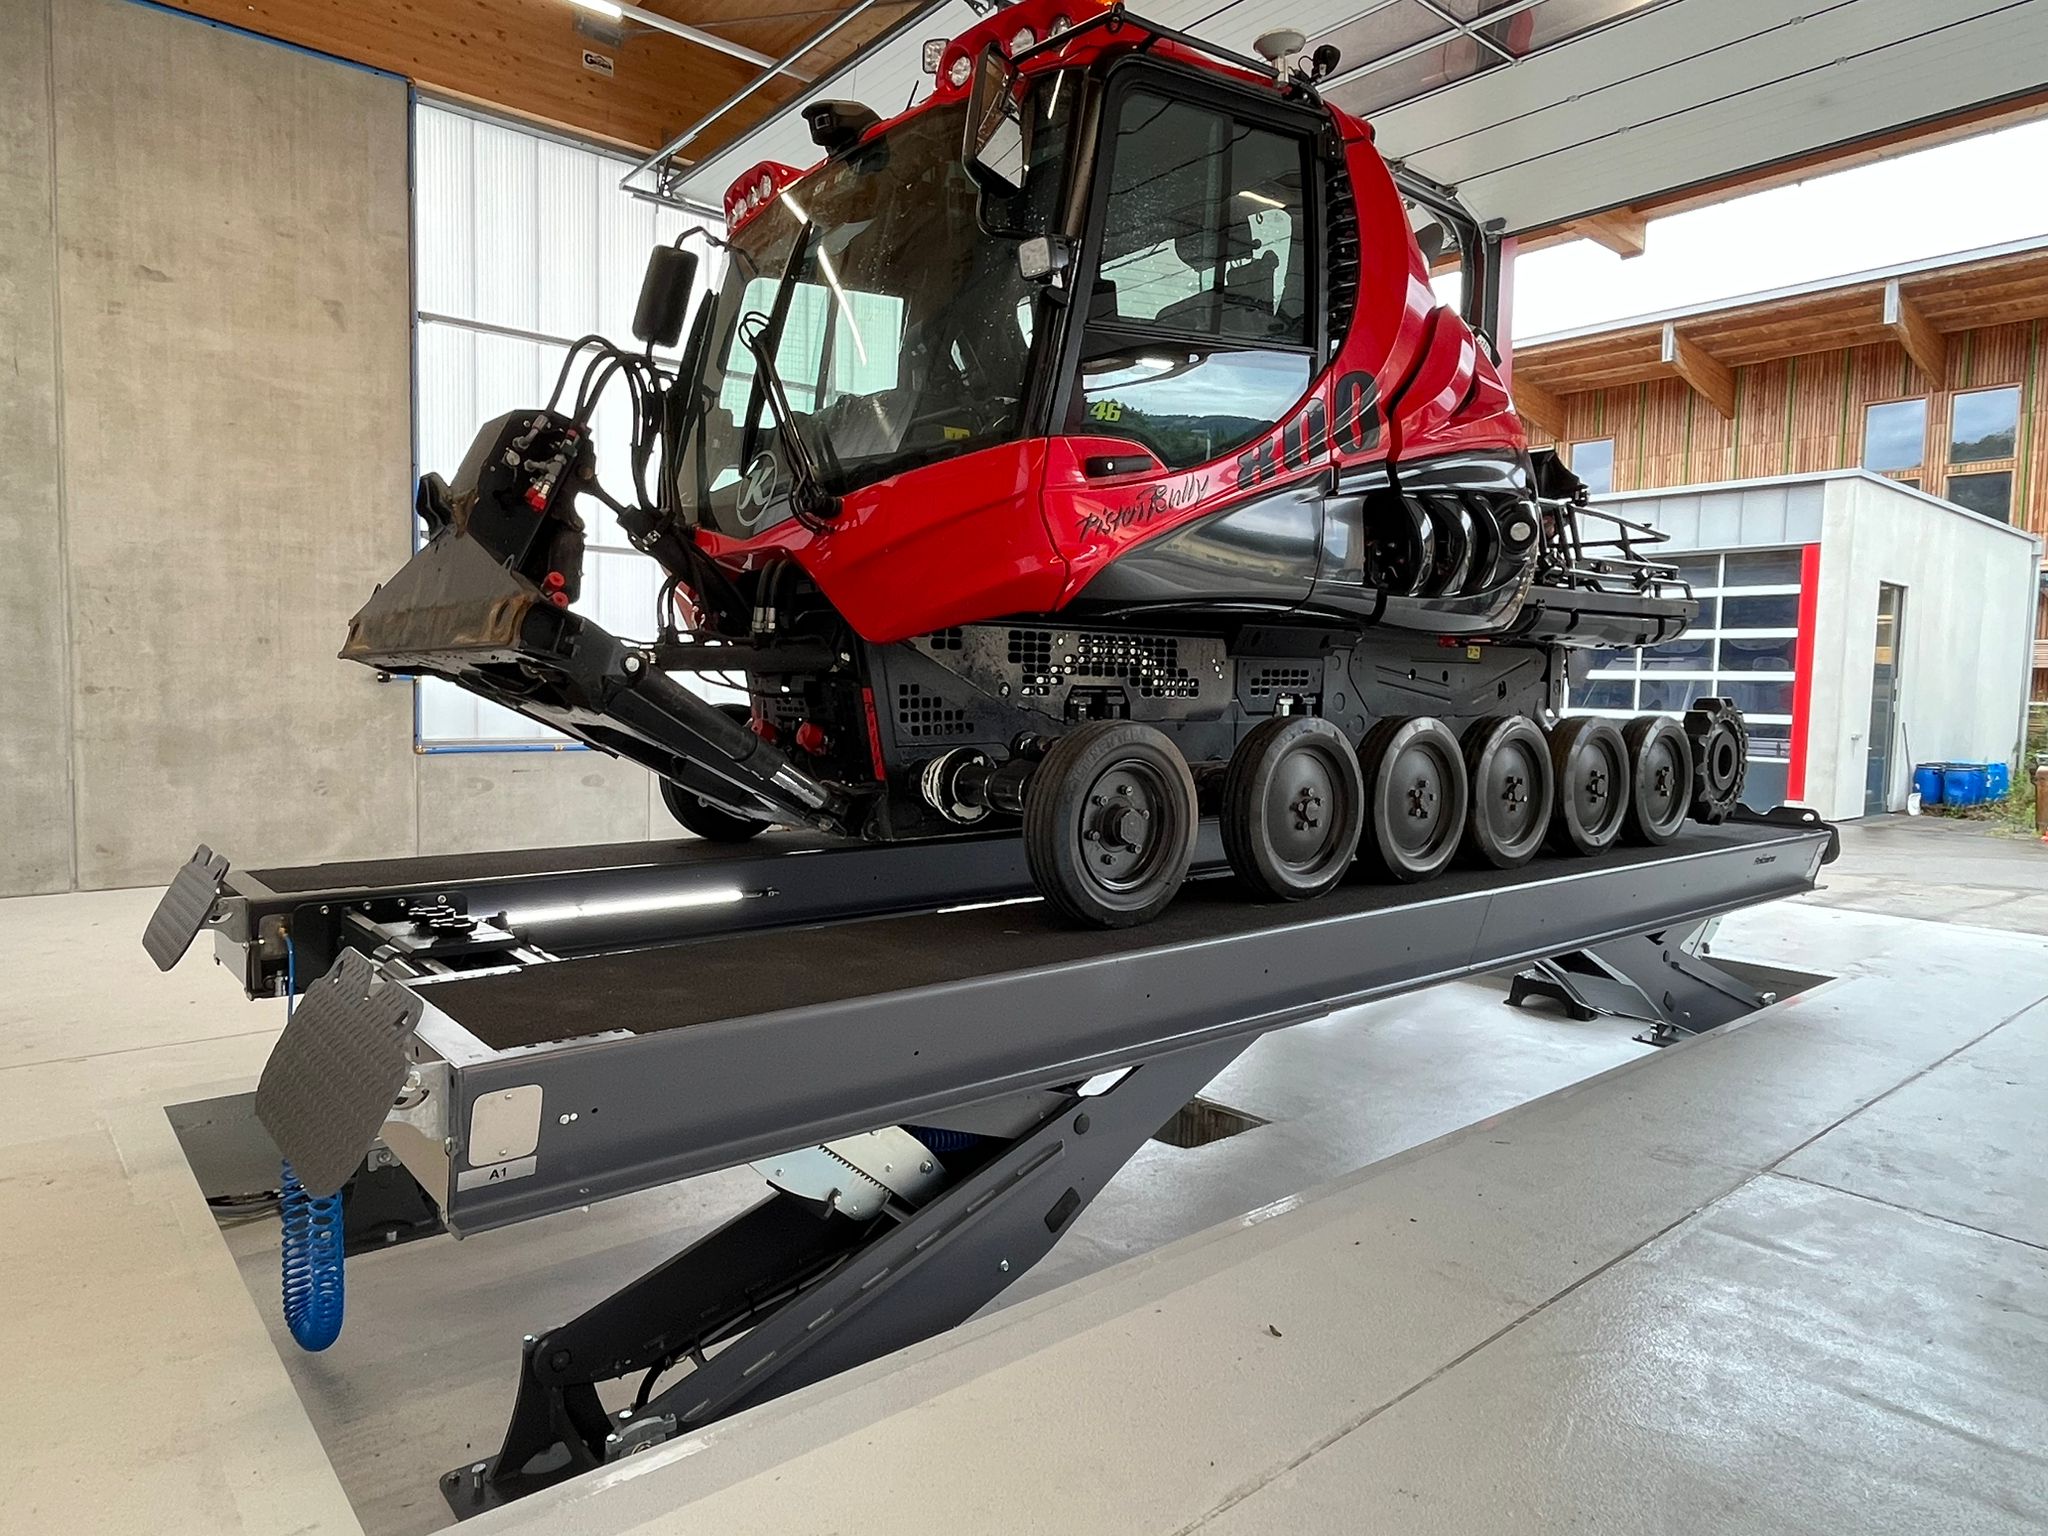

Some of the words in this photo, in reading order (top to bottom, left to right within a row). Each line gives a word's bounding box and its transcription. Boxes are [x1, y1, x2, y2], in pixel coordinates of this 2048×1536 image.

[1089, 401, 1121, 422] 46
[1237, 370, 1381, 490] 800
[488, 1166, 508, 1181] A1
